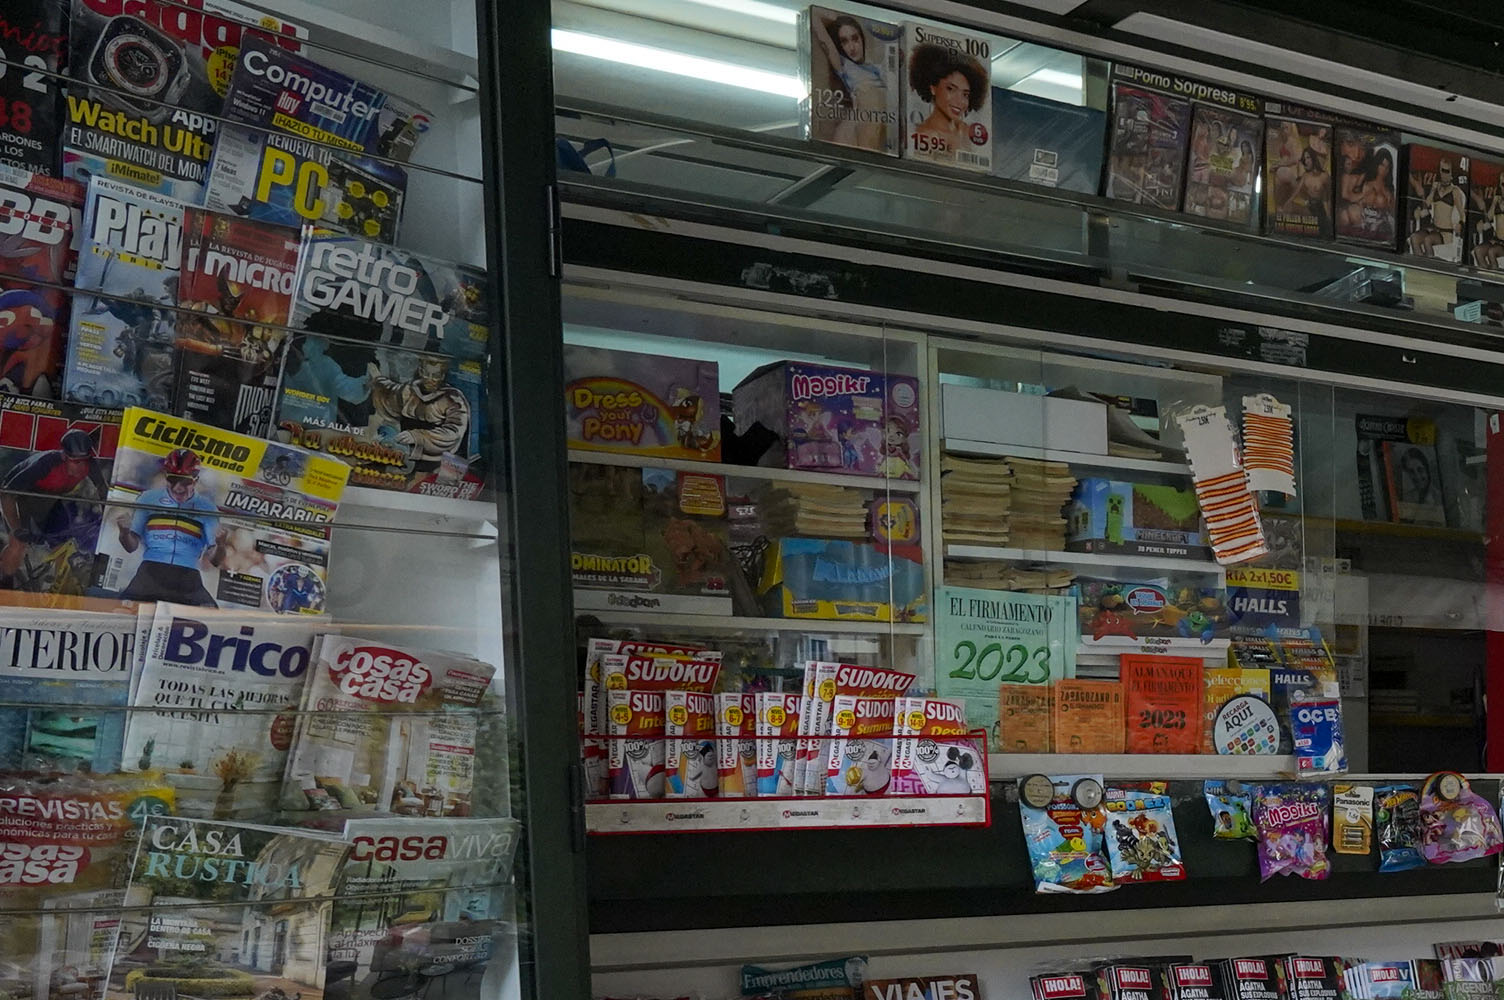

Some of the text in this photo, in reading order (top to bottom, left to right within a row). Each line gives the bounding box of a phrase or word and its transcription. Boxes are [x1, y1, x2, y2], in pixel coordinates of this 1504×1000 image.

[965, 38, 989, 59] 100
[243, 50, 381, 121] Computer
[815, 88, 844, 108] 122
[1133, 69, 1237, 106] Porno Sorpresa
[67, 95, 158, 146] Watch
[71, 128, 177, 173] EL SMARTWATCH DEL
[267, 134, 333, 165] RENUEVA TU
[97, 180, 147, 199] REVISTA DE
[256, 147, 330, 221] PC
[310, 241, 419, 296] retro
[303, 271, 451, 339] GAMER
[574, 388, 642, 409] Dress
[793, 373, 870, 400] Magiki
[303, 415, 366, 436] MÁS ALLÁ DE
[583, 417, 644, 446] Pony
[133, 414, 251, 464] Ciclismo
[208, 456, 245, 474] fondo
[951, 597, 1053, 625] EL FIRMAMENTO
[163, 616, 311, 679] Brico
[329, 644, 430, 684] Cosas
[628, 659, 714, 684] SUDOKU
[949, 640, 1051, 684] 2023
[158, 679, 205, 696] TODAS
[209, 684, 236, 699] LAS
[340, 671, 421, 704] casa
[837, 667, 912, 691] SUDOKU
[1274, 673, 1311, 685] HALLS
[1139, 709, 1187, 729] 2023
[1221, 700, 1249, 722] RECARGA
[152, 825, 245, 858] CASA
[743, 965, 845, 990] Emprendedores
[1120, 969, 1149, 983] ¡HOLA!
[1179, 967, 1209, 982] ¡HOLA!
[1238, 961, 1265, 974] ¡HOLA!
[1296, 961, 1322, 974] ¡HOLA!
[1044, 978, 1081, 992] ¡HOLA!
